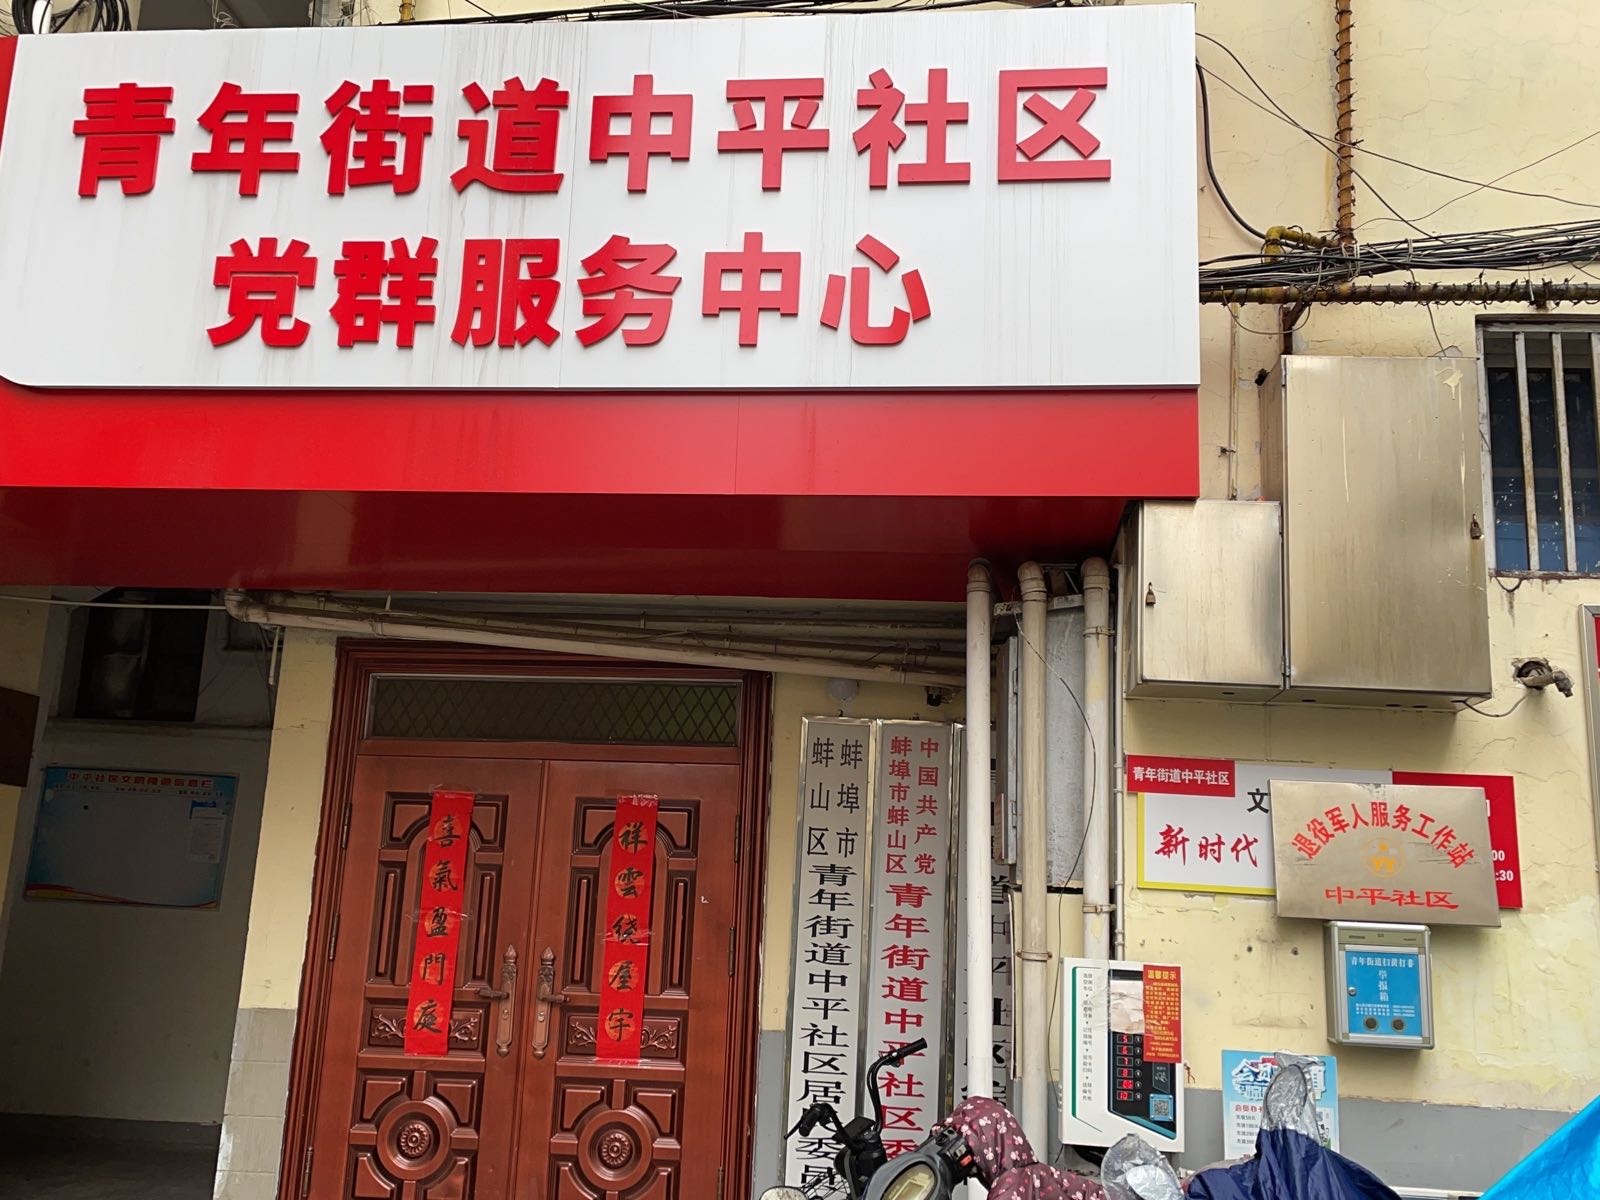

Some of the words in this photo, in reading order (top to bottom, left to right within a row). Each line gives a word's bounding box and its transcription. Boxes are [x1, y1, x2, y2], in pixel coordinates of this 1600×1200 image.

[73, 67, 1111, 196] 青年街道中平社区
[207, 231, 930, 348] 党群服务中心
[807, 737, 834, 856] 蚌山区
[837, 738, 863, 858] 蚌埠市
[885, 736, 912, 874] 蚌埠市蚌山区
[914, 737, 939, 875] 中国共产党
[1133, 766, 1230, 786] 青年街道中平社区
[1291, 801, 1476, 869] 退役军人服务工作站
[1155, 824, 1259, 868] 新时代
[1325, 885, 1459, 909] 中平社区
